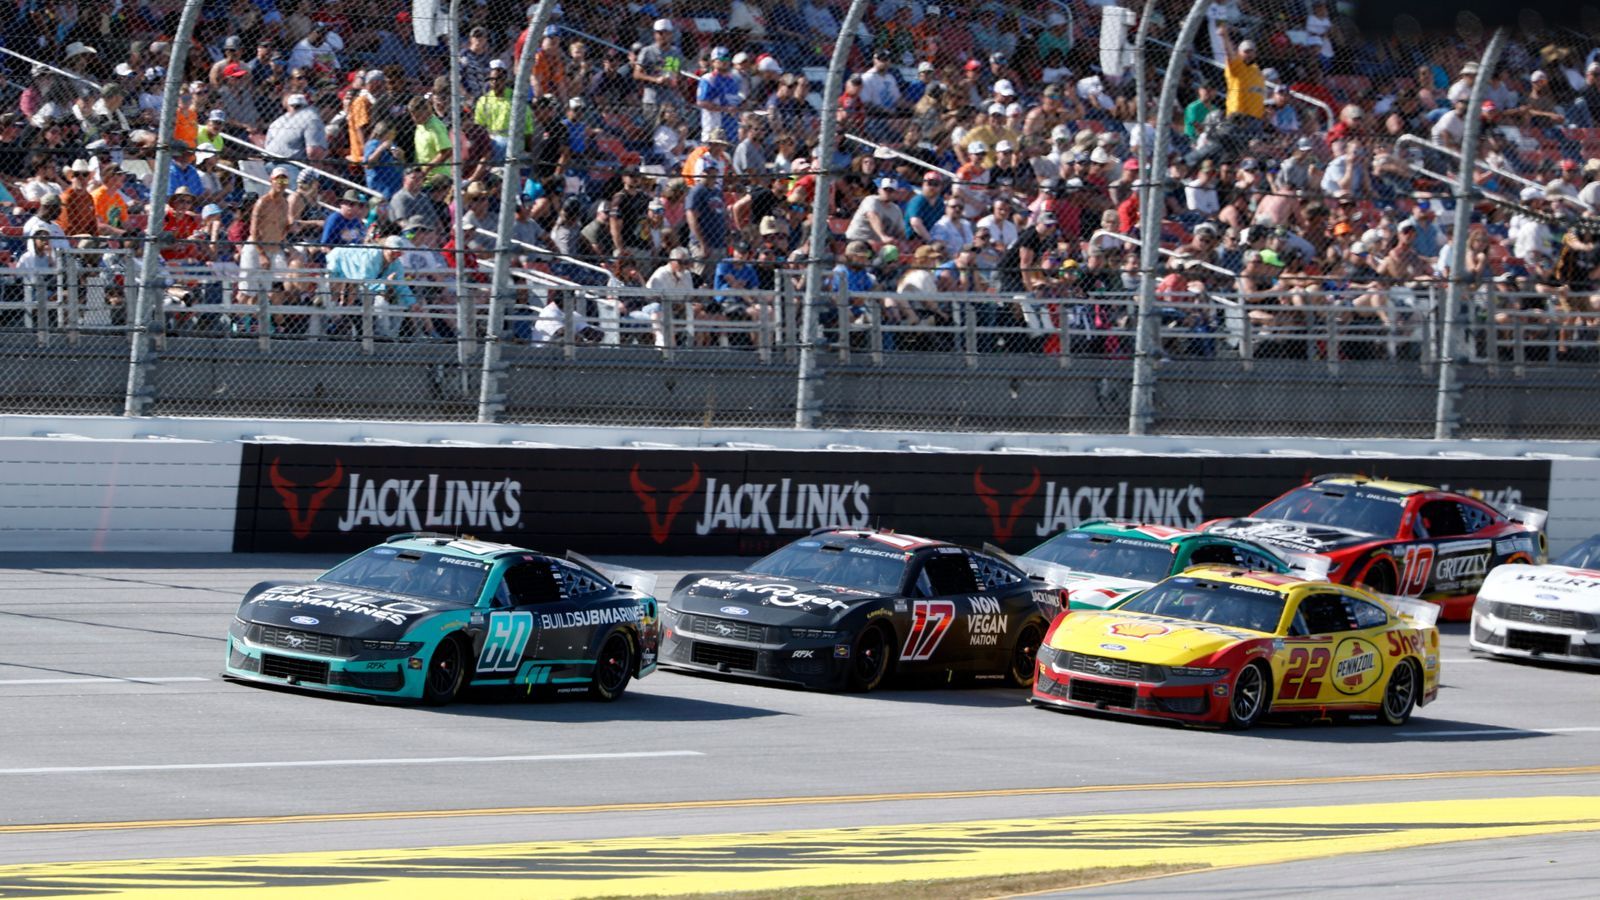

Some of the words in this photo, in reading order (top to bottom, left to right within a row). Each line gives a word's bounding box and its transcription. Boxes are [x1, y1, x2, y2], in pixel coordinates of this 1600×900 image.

[338, 474, 424, 531] JACK
[425, 474, 521, 531] LINK'S
[696, 478, 776, 535] JACK
[778, 478, 870, 529] LINK'S
[1036, 481, 1114, 536] JACK
[1116, 481, 1204, 531] LINK'S
[439, 556, 483, 568] PREECE
[1398, 543, 1435, 597] 10
[1436, 553, 1491, 580] GRIZZLY
[734, 582, 849, 610] Kroger
[1229, 584, 1275, 596] LOGANO
[250, 592, 407, 626] SUBMARINES
[541, 605, 645, 629] BUILDSUBMARINES
[968, 597, 1000, 614] NON
[899, 600, 955, 661] 17
[967, 614, 1008, 633] VEGAN
[476, 611, 533, 672] 60
[970, 634, 998, 646] NATION
[1277, 648, 1331, 699] 22
[1336, 652, 1374, 677] PENNZOIL
